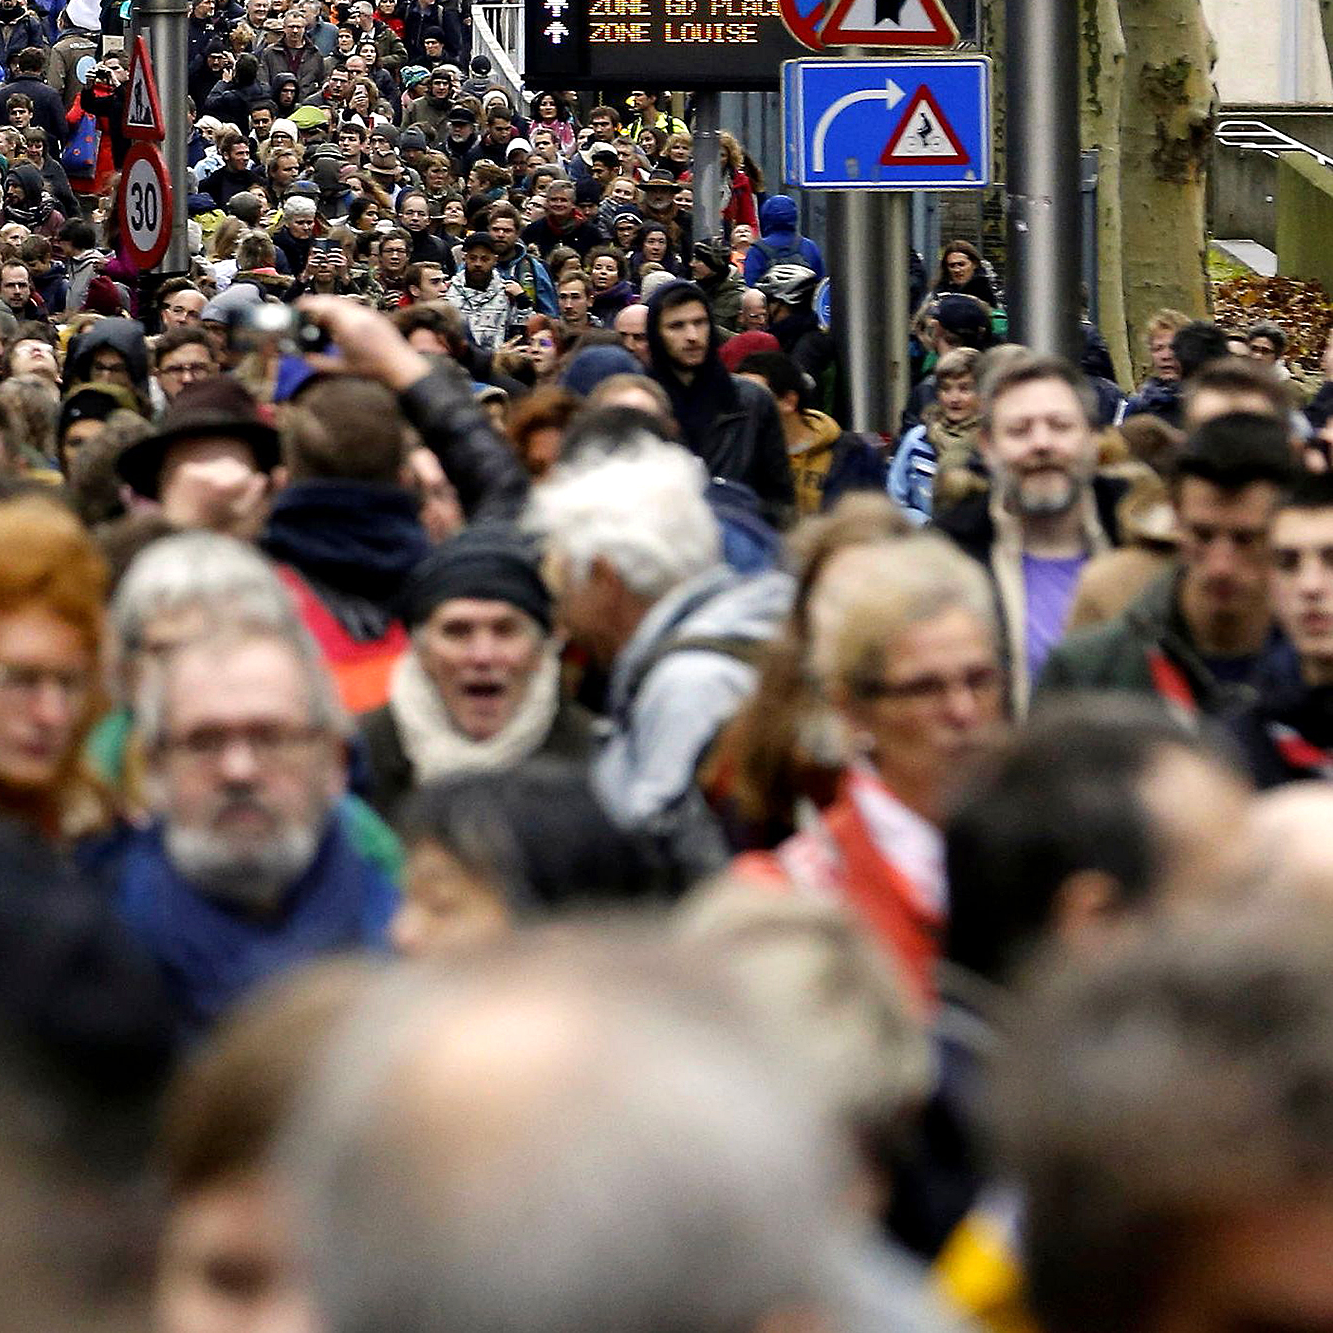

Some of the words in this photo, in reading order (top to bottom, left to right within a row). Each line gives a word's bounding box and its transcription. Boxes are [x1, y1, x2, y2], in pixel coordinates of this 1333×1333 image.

[589, 22, 652, 43] ZONE
[664, 22, 758, 43] LOUISE
[131, 182, 158, 232] 30
